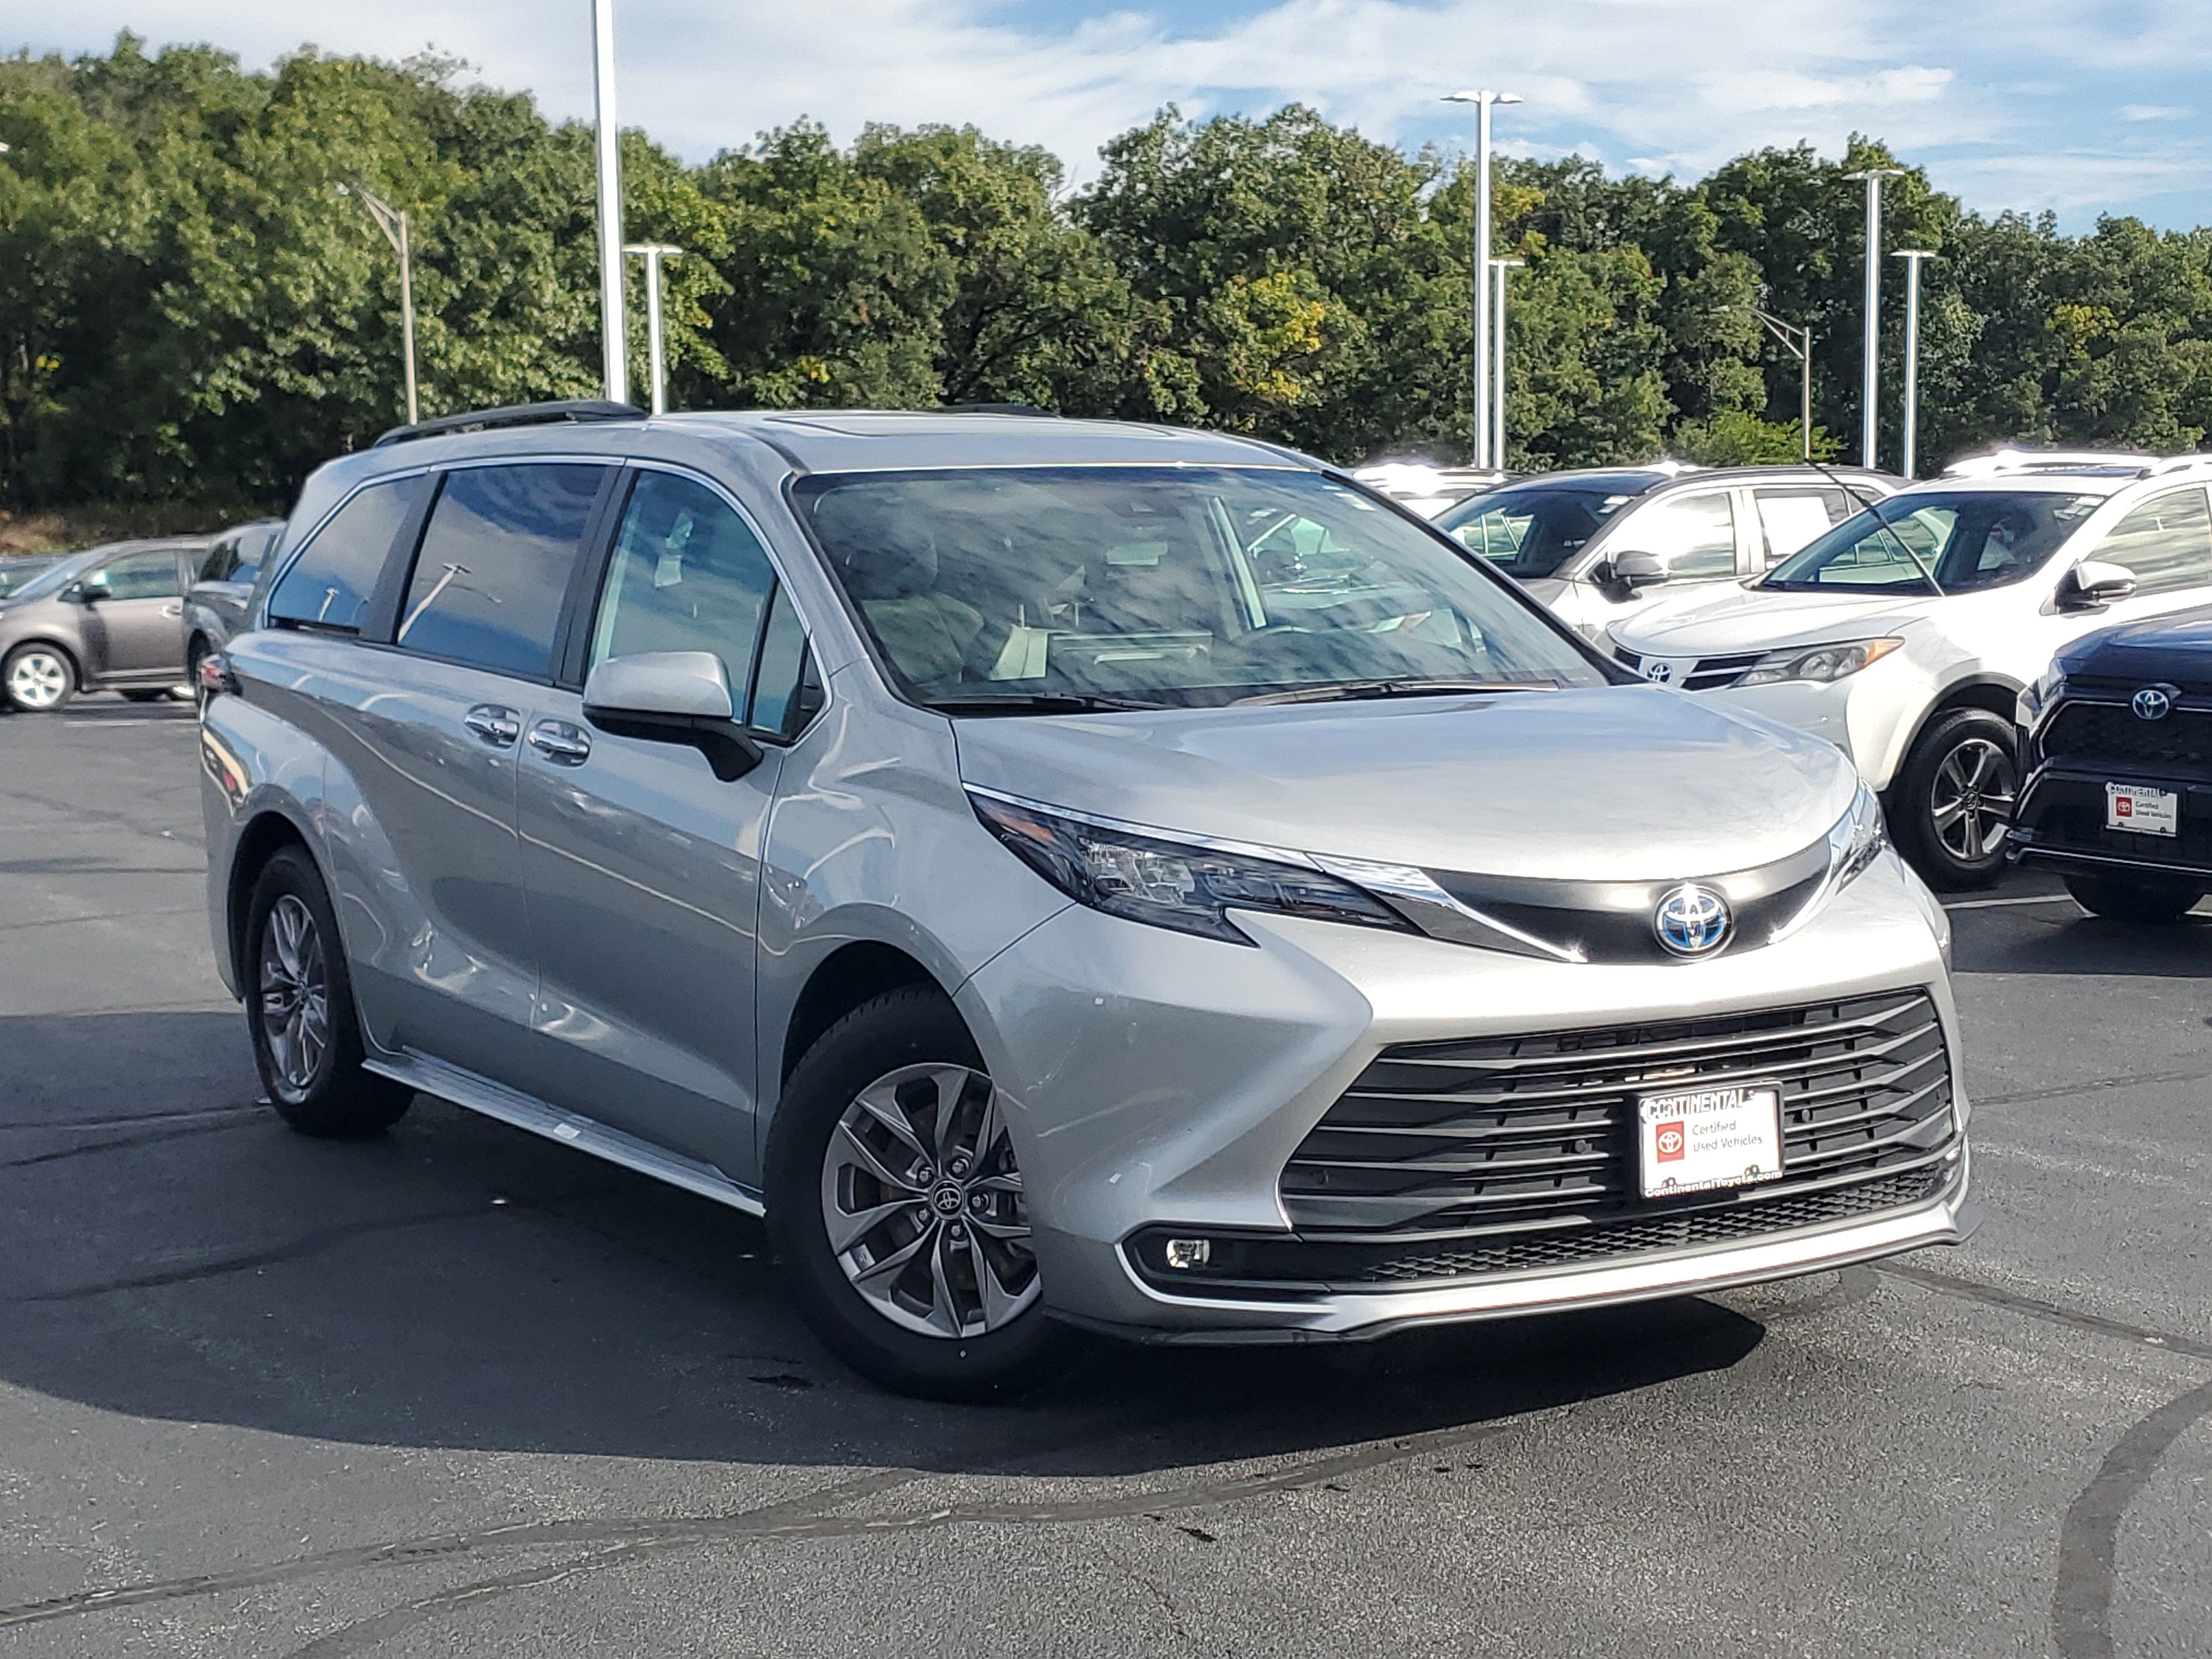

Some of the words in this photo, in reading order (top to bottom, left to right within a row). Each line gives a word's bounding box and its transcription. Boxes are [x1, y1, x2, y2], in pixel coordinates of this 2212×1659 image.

[1646, 1089, 1744, 1119] CONTINENTAL
[1692, 1120, 1736, 1135] Certified
[1693, 1139, 1718, 1152] Used
[1721, 1135, 1762, 1148] Vehicles
